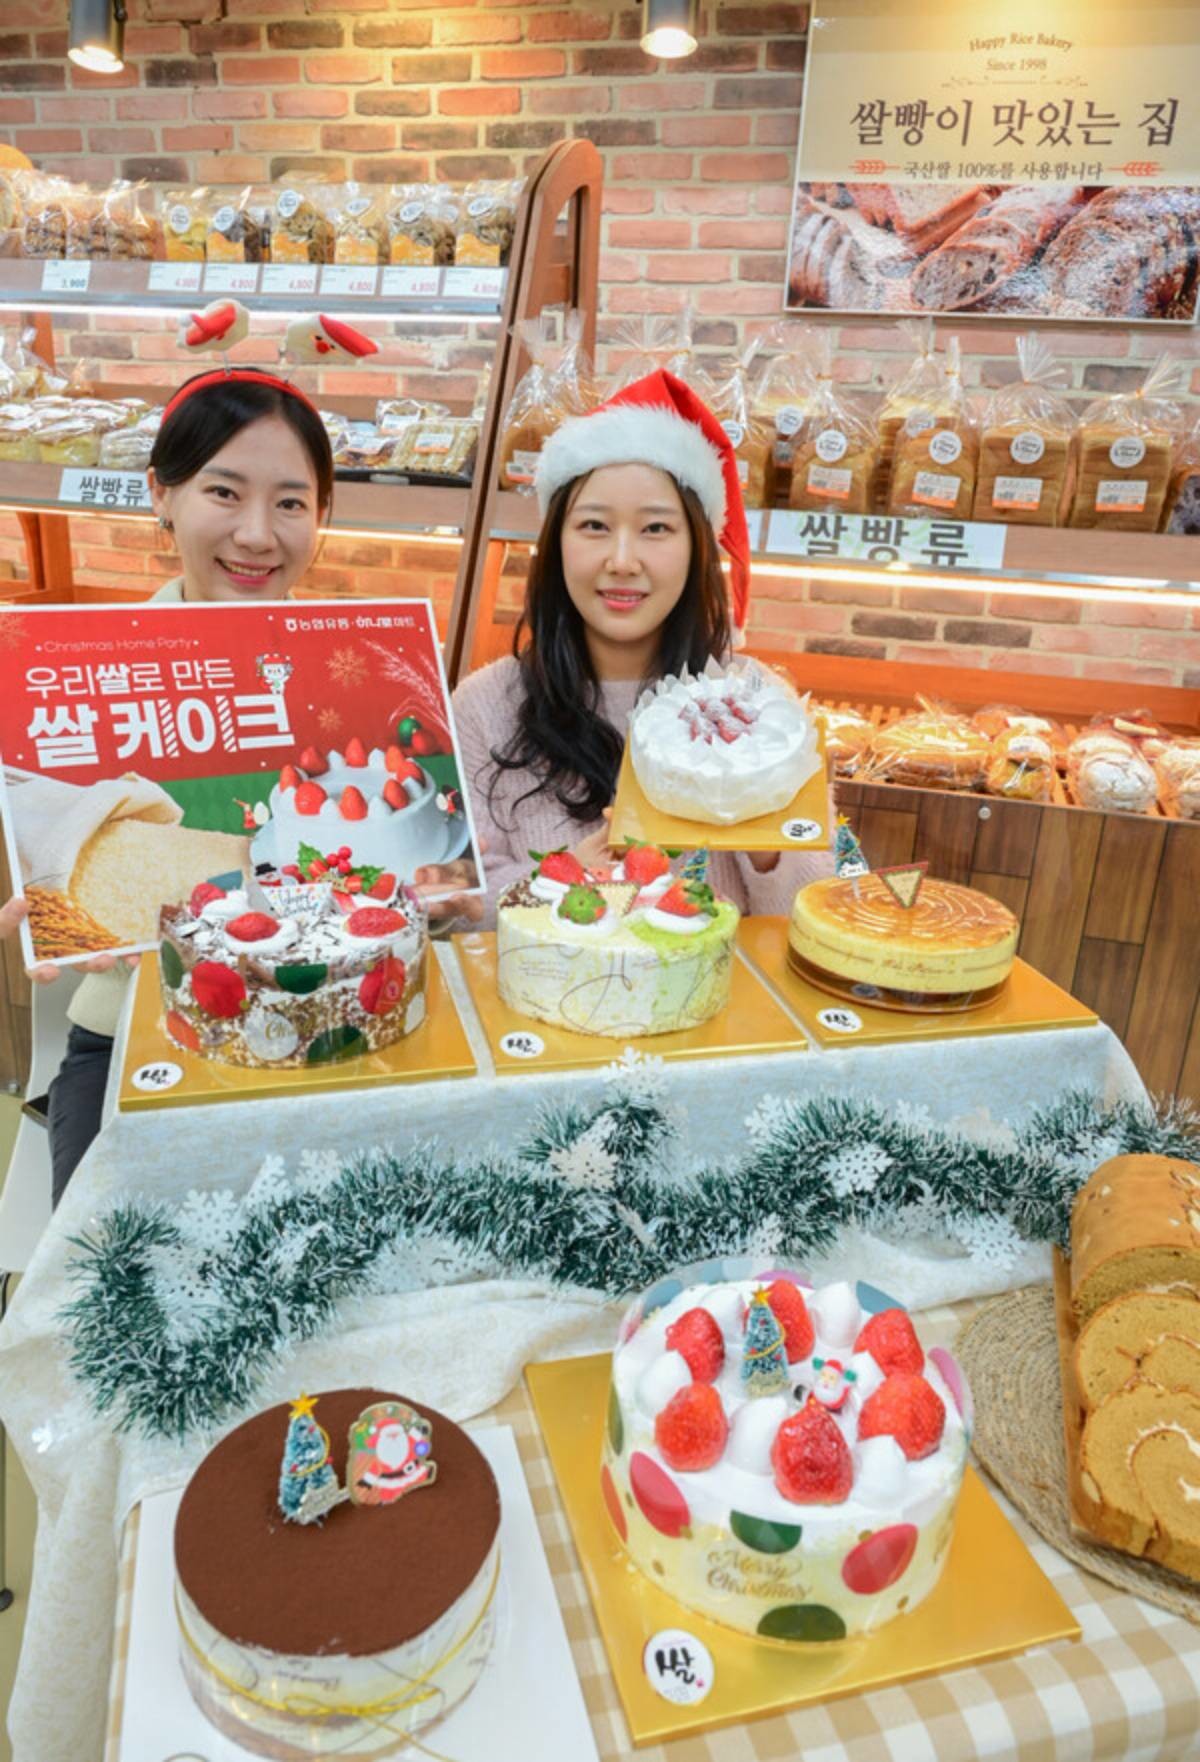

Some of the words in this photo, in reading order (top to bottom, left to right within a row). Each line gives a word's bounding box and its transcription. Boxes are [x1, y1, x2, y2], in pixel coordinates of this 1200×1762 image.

[969, 36, 1007, 53] Happy
[1009, 33, 1035, 46] Rice
[1036, 33, 1074, 53] Bakery
[986, 58, 1016, 71] Since
[1019, 57, 1048, 71] 1998
[850, 98, 973, 147] 쌀빵이
[992, 98, 1120, 147] 맛있는
[1137, 98, 1180, 147] 집
[903, 161, 952, 180] 국산쌀
[956, 161, 1015, 180] 100%를
[1020, 162, 1104, 181] 사용합니다
[79, 475, 144, 506] 쌀빵류
[43, 639, 114, 653] Christmas
[116, 638, 155, 651] Home
[157, 636, 193, 651] Party
[25, 660, 167, 700] 우리쌀로
[171, 657, 235, 692] 만든
[27, 704, 100, 768] 쌀
[109, 691, 296, 762] 케이크
[706, 1549, 803, 1580] Merry
[705, 1570, 813, 1600] Christmas
[654, 1646, 696, 1685] 쌀
